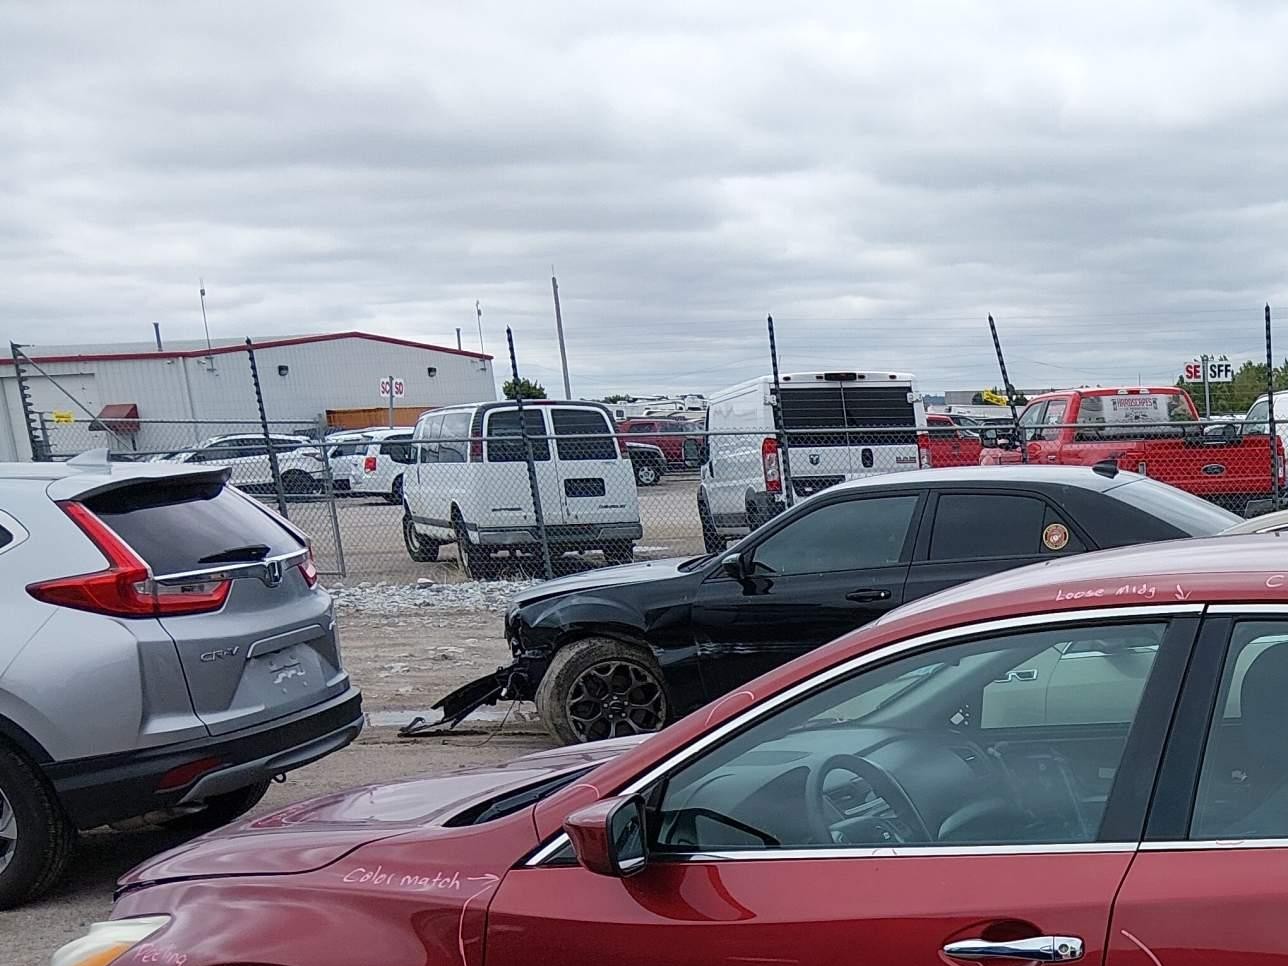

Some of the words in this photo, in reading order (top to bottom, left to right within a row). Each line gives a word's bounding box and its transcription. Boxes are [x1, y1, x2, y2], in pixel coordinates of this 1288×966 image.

[1185, 364, 1202, 379] SE
[1210, 364, 1231, 378] SFF
[1056, 589, 1105, 601] Loose
[343, 865, 396, 884] Color
[400, 871, 460, 890] match
